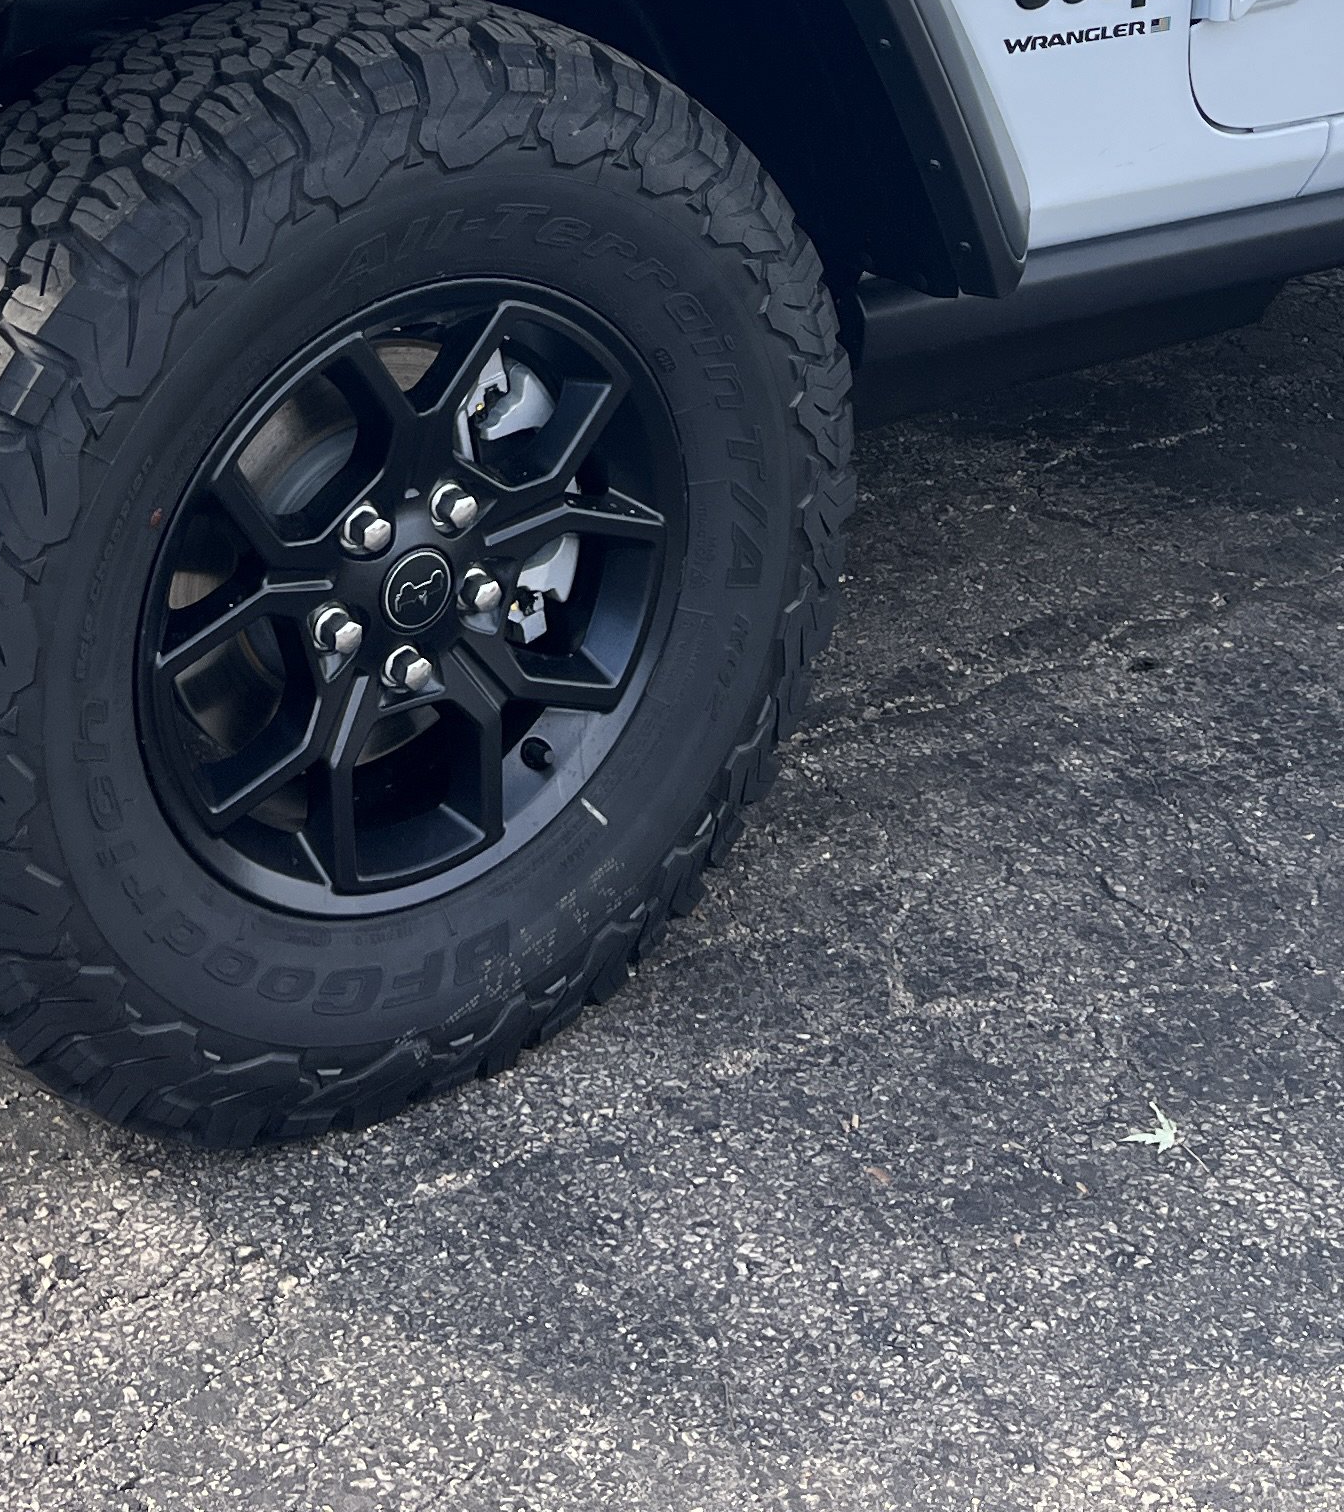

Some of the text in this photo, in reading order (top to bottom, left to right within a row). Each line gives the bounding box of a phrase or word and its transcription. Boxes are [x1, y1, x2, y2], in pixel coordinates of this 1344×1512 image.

[1003, 21, 1146, 55] WRANGLER
[327, 202, 747, 413] All-Terrain
[724, 424, 770, 590] T/A
[72, 696, 513, 1017] BFGoodrich
